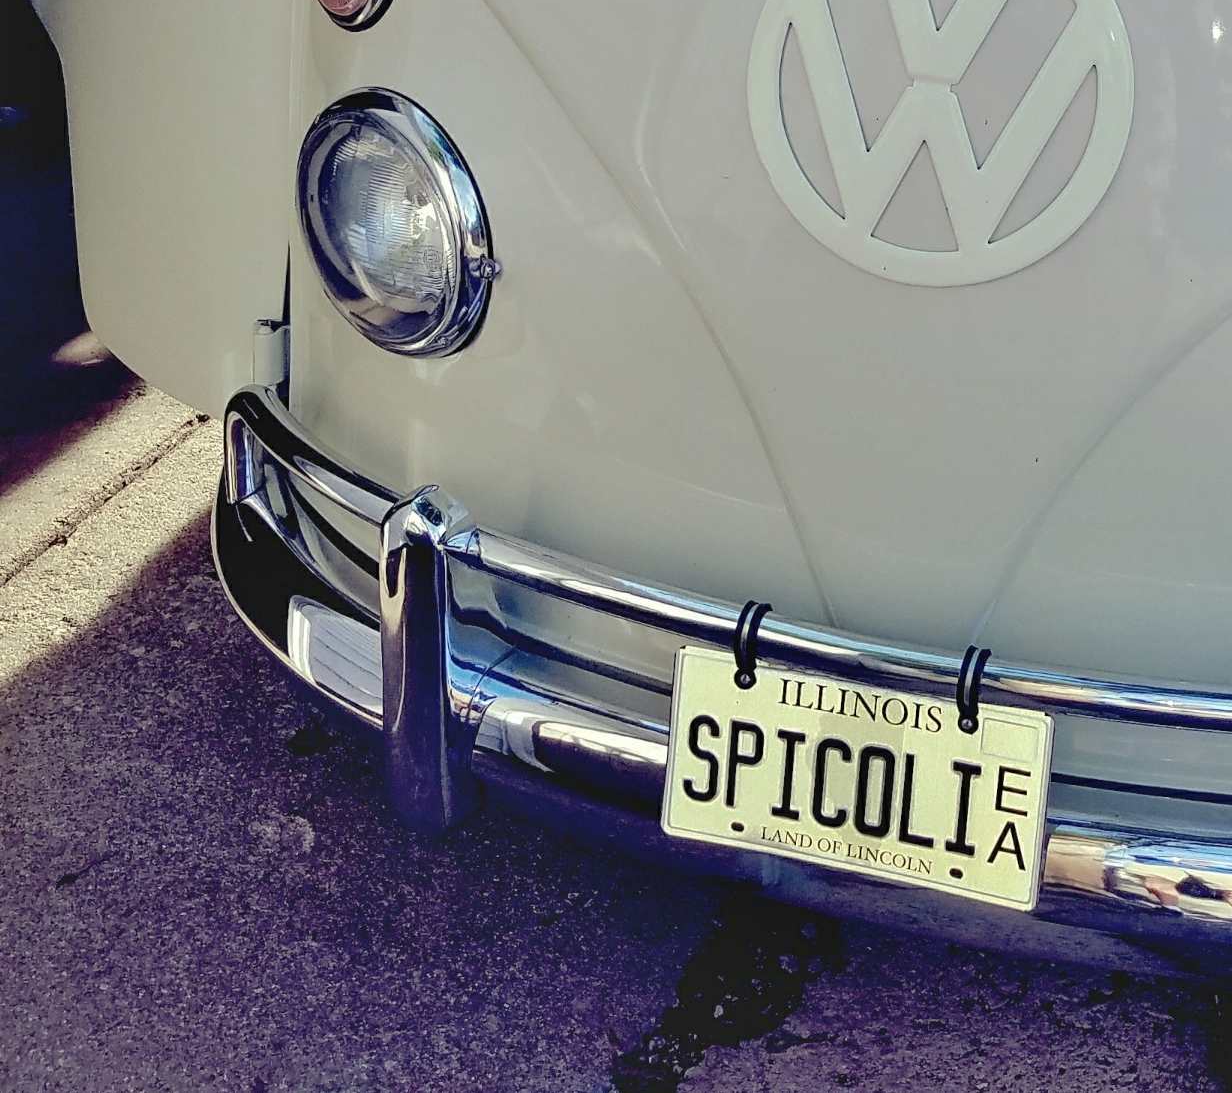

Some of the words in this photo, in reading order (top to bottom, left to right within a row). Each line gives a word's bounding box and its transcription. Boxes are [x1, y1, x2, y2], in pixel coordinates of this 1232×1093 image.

[777, 677, 942, 733] ILLINOIS
[683, 714, 982, 856] SPICOLI
[761, 826, 813, 848] LAND
[817, 837, 843, 855] OF
[845, 843, 933, 874] LINCOLN
